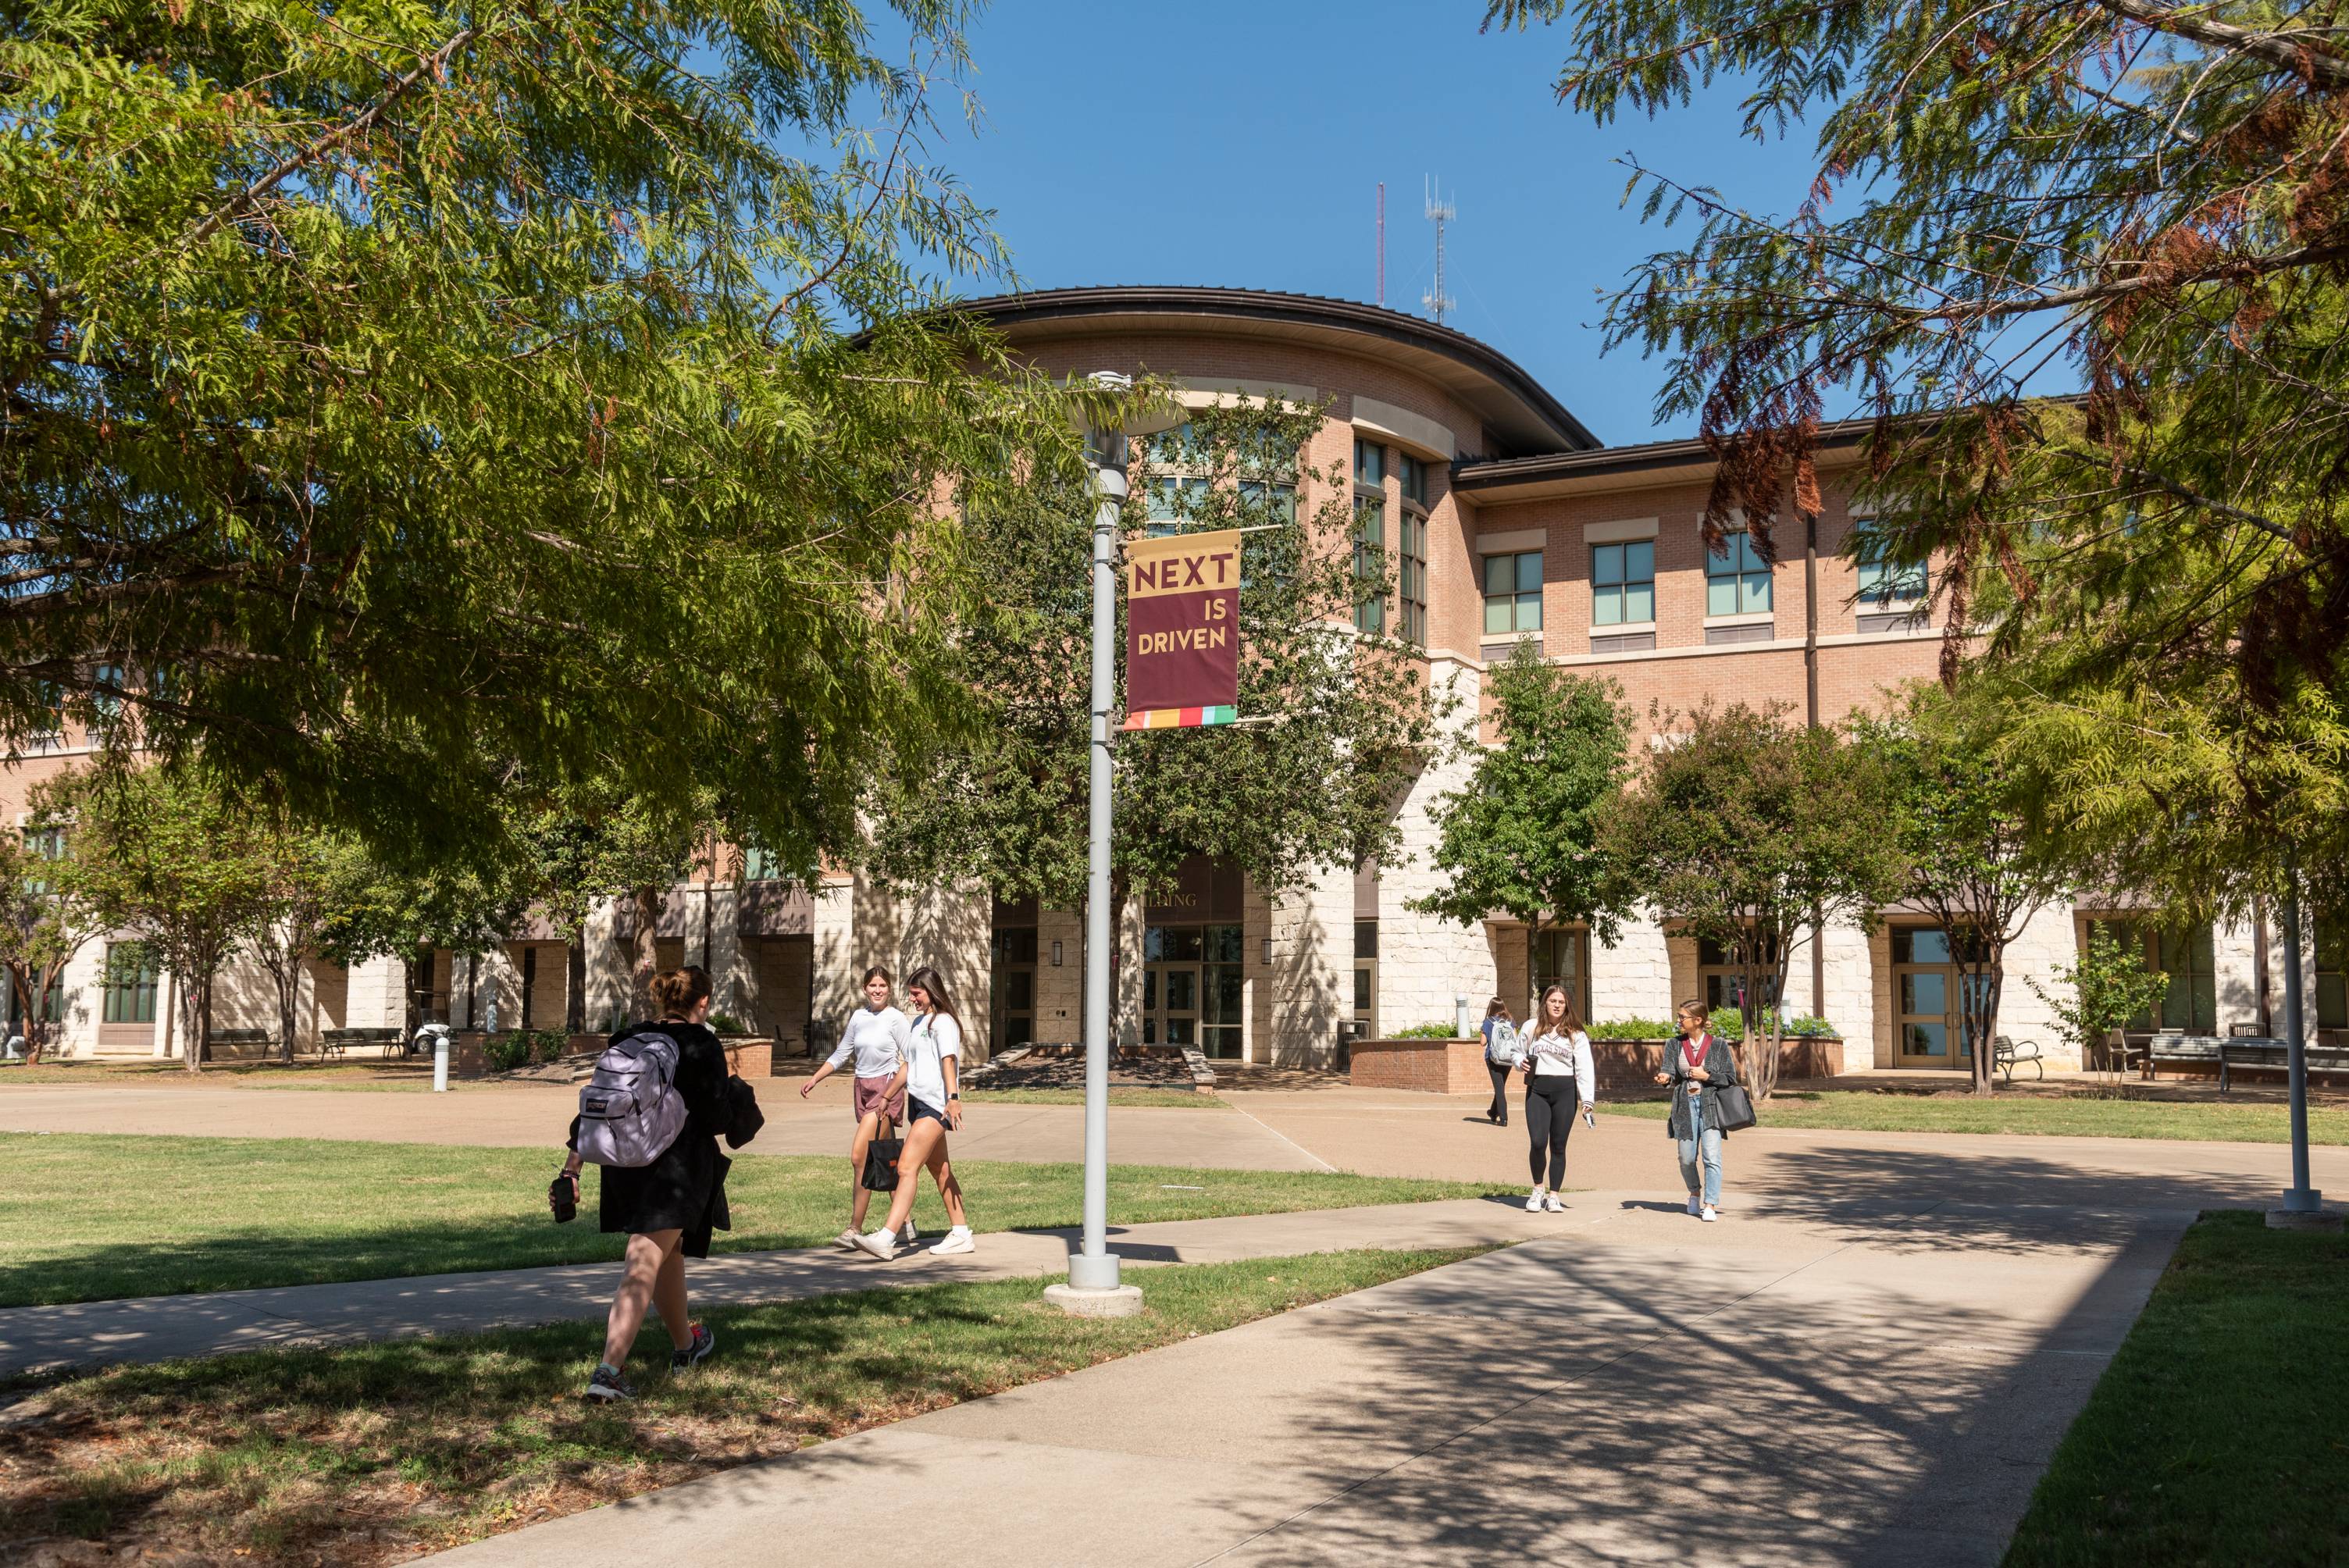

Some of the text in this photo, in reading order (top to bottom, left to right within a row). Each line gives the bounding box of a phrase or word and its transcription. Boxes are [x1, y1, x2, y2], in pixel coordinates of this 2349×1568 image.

[1135, 552, 1234, 593] NEXT
[1205, 598, 1227, 621] IS
[1138, 626, 1225, 655] DRIVEN
[1144, 893, 1197, 907] ILDING
[1534, 1043, 1570, 1059] TEXAS STATE
